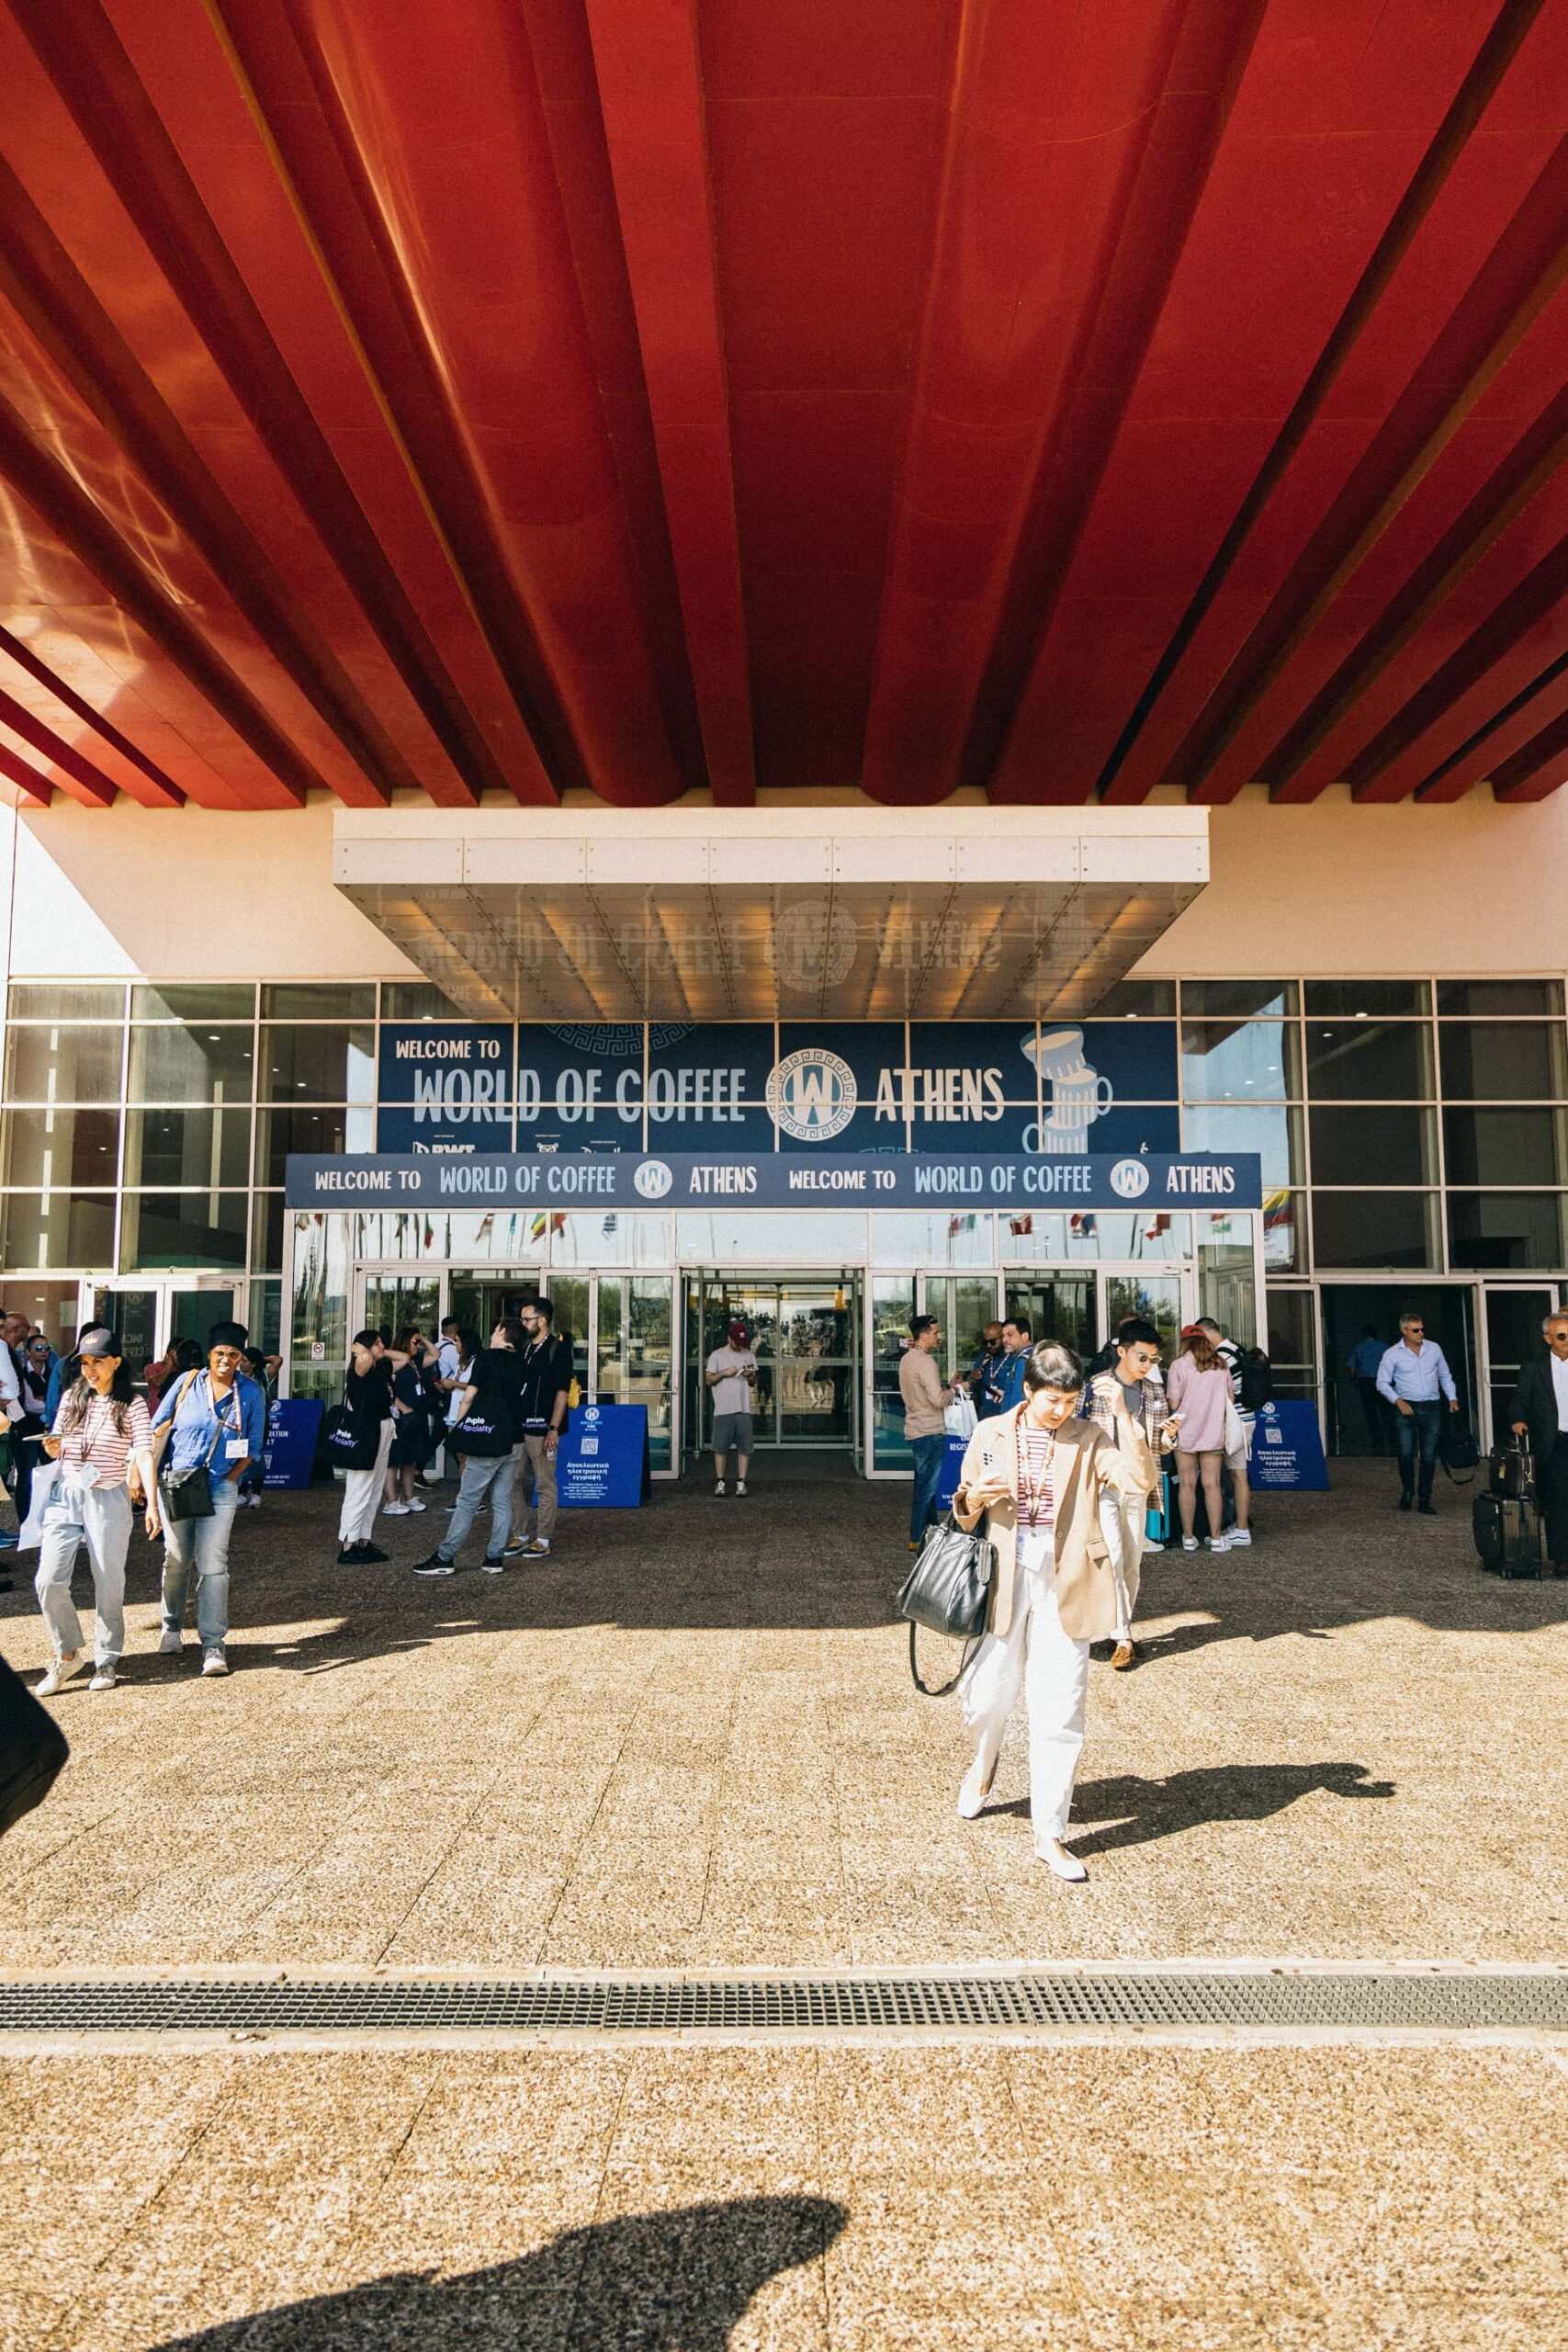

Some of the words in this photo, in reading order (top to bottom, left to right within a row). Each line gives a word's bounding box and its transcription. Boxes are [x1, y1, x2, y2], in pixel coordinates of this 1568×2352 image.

[396, 1040, 471, 1058] WELCOME
[478, 1040, 501, 1058] TO
[413, 1069, 540, 1122] WORLD
[556, 1069, 602, 1122] OF
[616, 1069, 746, 1122] COFFEE
[874, 1068, 1004, 1122] ATHENS
[315, 1171, 392, 1190] WELCOME
[399, 1170, 422, 1189] TO
[440, 1167, 507, 1193] WORLD
[515, 1167, 540, 1192] OF
[547, 1166, 615, 1192] COFFEE
[689, 1166, 757, 1193] ATHENS
[789, 1170, 866, 1189] WELCOME
[873, 1170, 896, 1189] TO
[915, 1166, 983, 1193] WORLD
[990, 1166, 1016, 1192] OF
[1023, 1166, 1092, 1192] COFFEE
[1167, 1166, 1235, 1193] ATHENS
